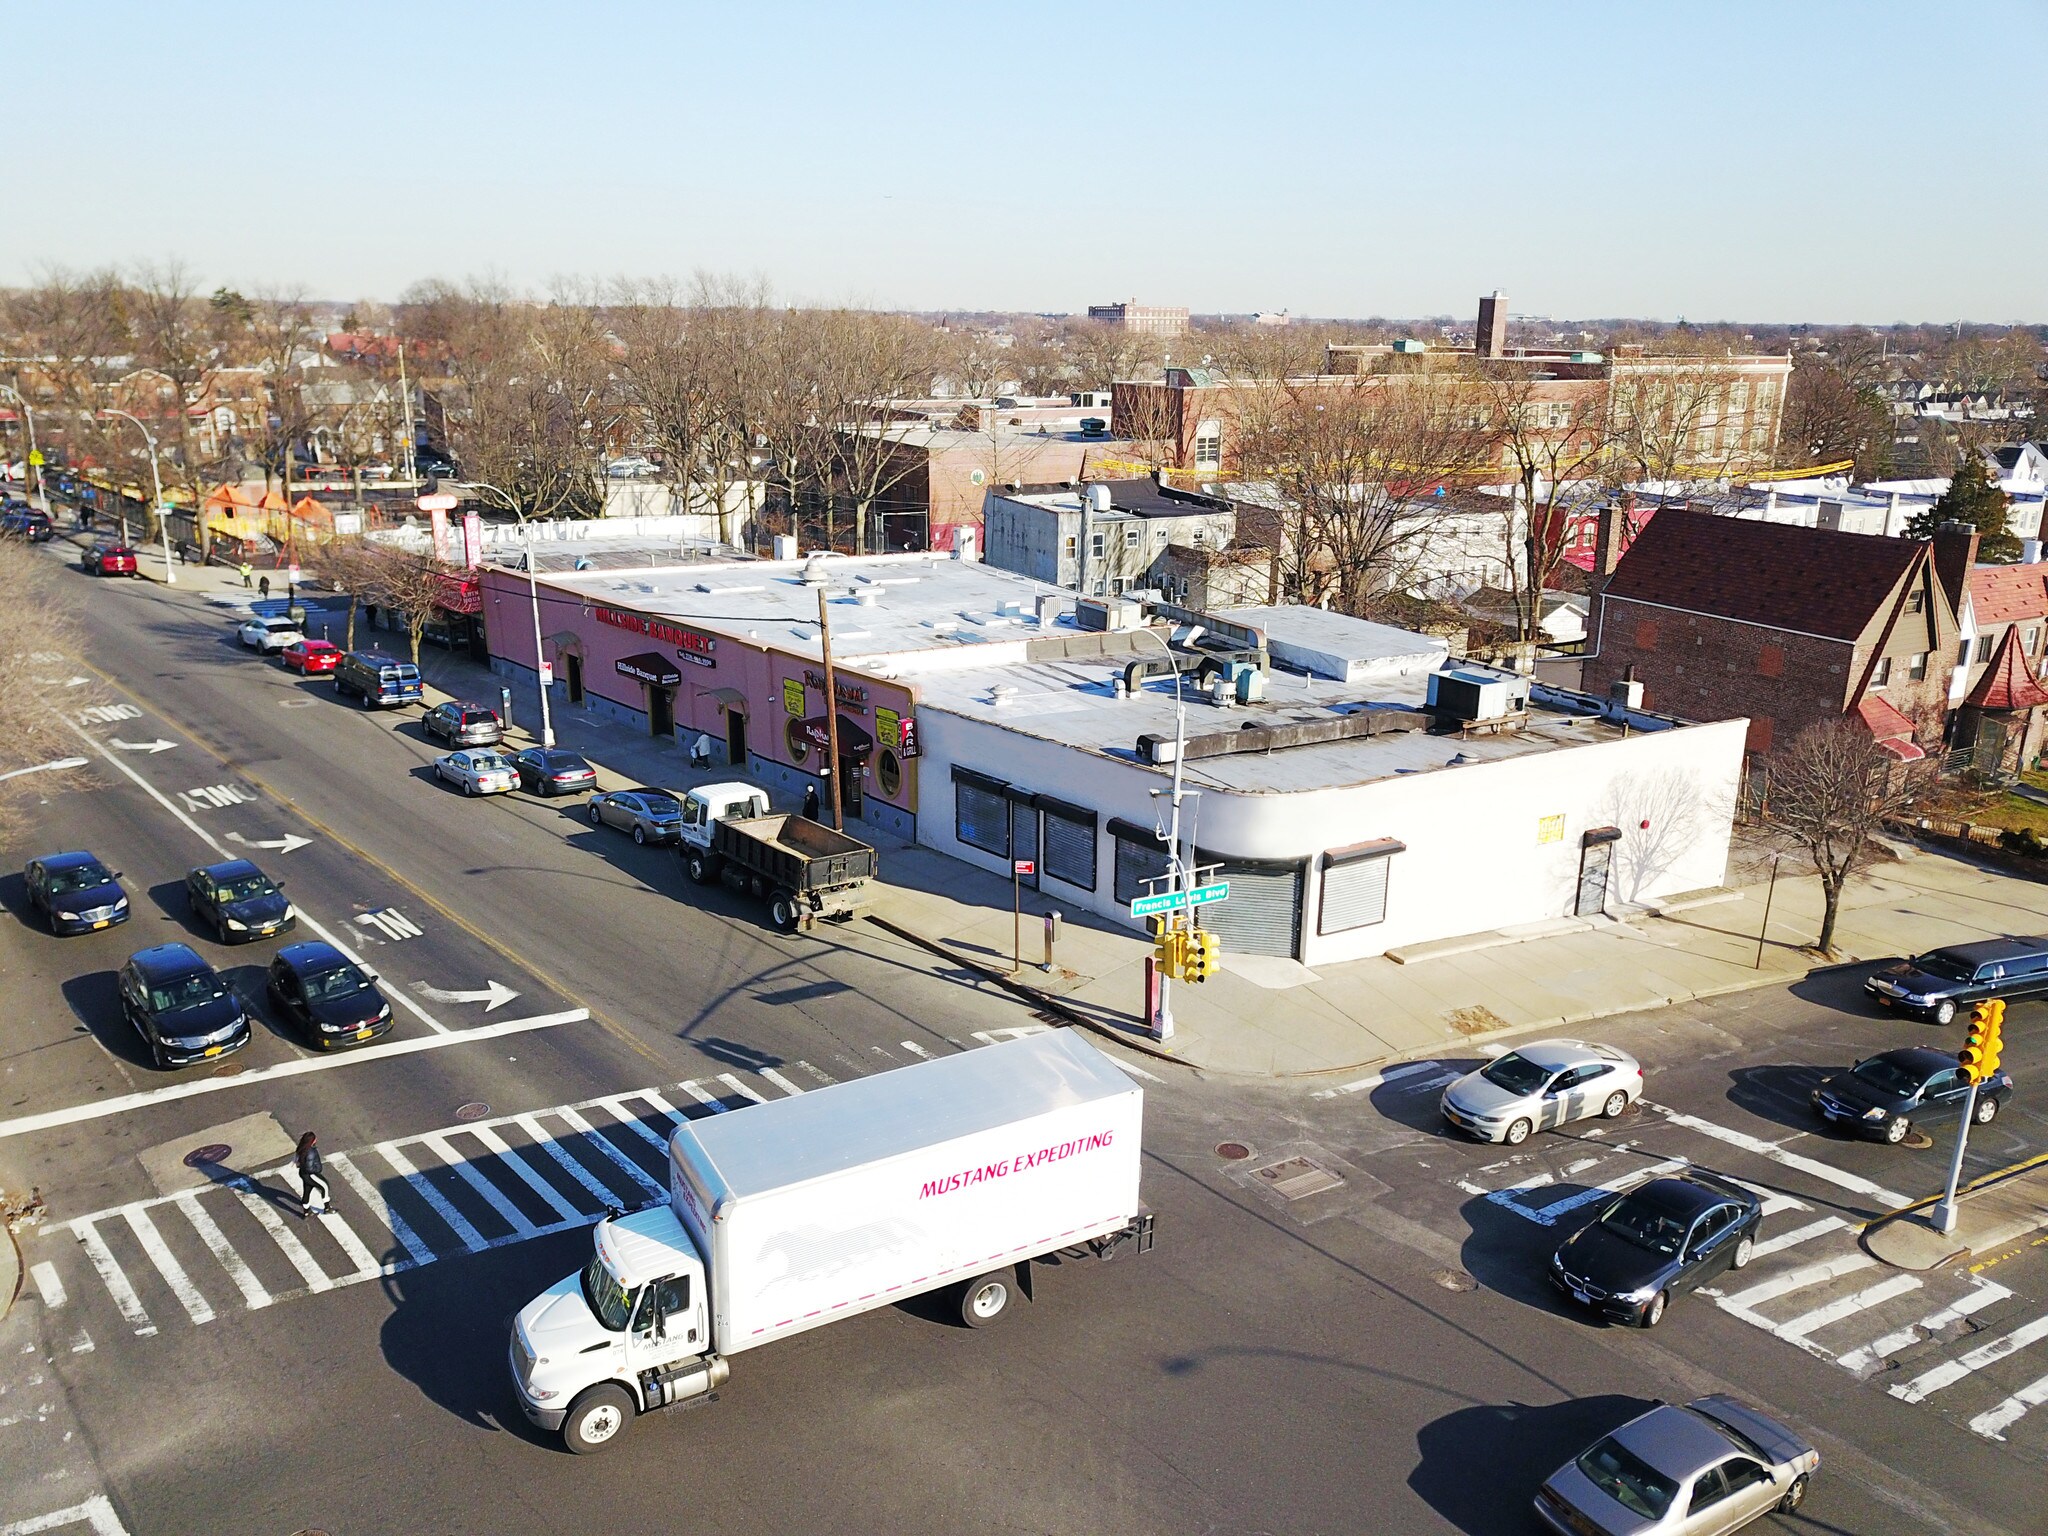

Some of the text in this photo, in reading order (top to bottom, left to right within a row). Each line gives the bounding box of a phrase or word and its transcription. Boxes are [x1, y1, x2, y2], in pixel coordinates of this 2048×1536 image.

[595, 607, 709, 654] HILLSIDE BANQUET
[76, 703, 143, 726] ONLY
[905, 722, 914, 746] BAR
[177, 783, 257, 812] ONLY
[1136, 899, 1171, 912] Francis
[1205, 887, 1226, 899] Blvd
[919, 1130, 1114, 1200] MUSTANG EXPEDITING
